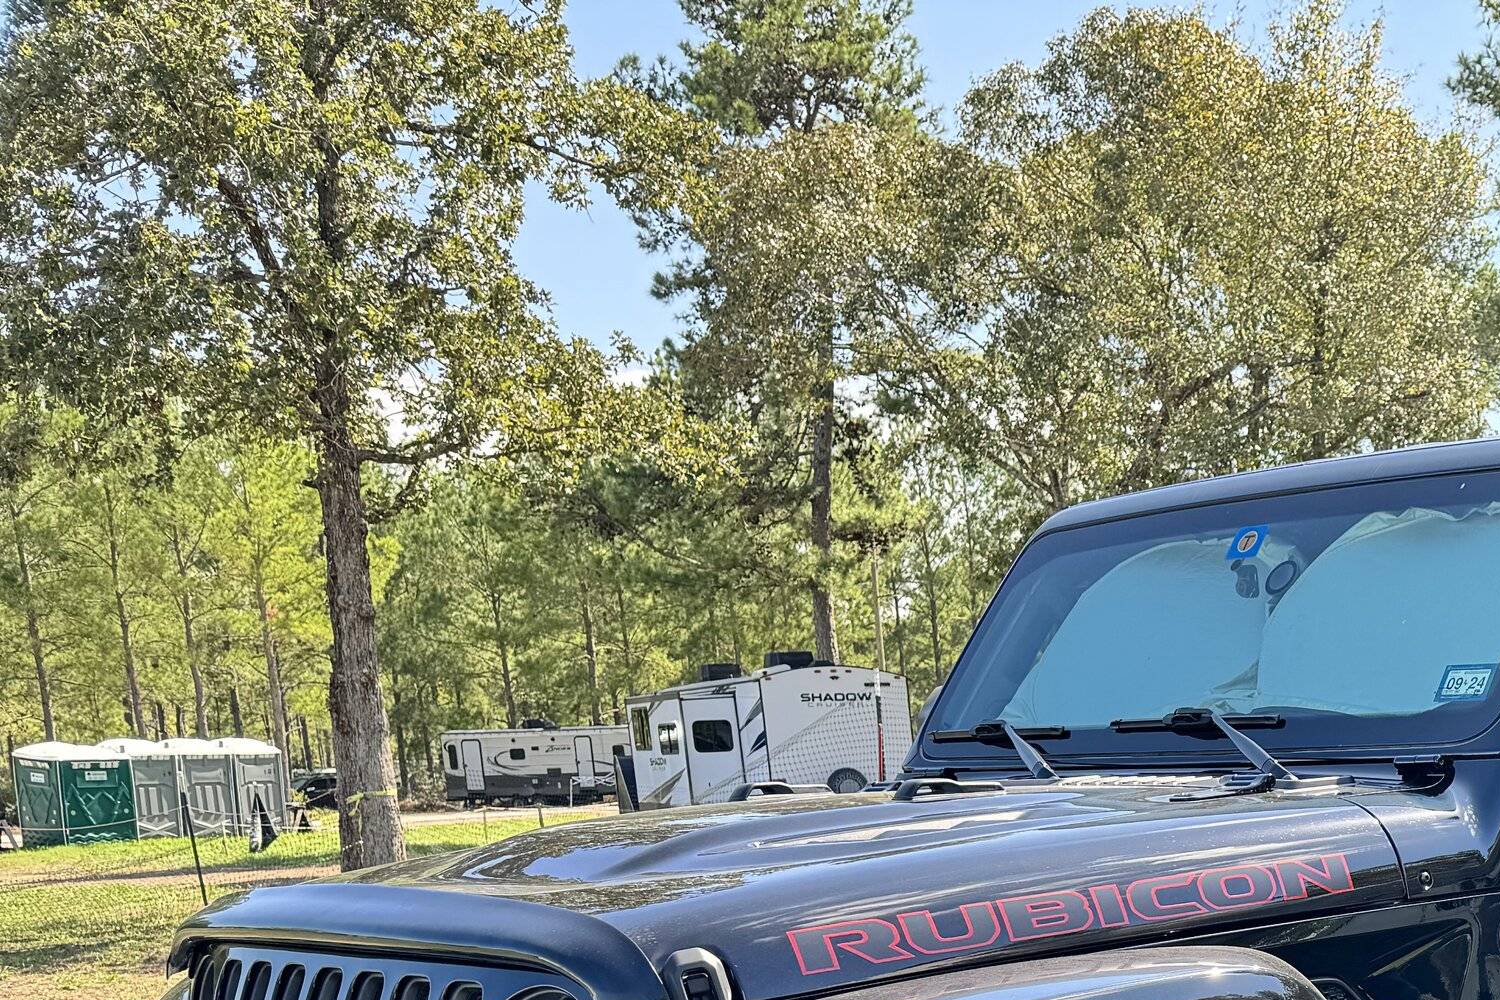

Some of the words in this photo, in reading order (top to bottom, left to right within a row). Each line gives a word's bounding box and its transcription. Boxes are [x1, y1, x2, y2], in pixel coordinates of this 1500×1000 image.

[1446, 677, 1464, 690] 09
[1467, 676, 1486, 690] 24
[800, 693, 873, 702] SHADOW
[786, 854, 1355, 976] RUBICON
